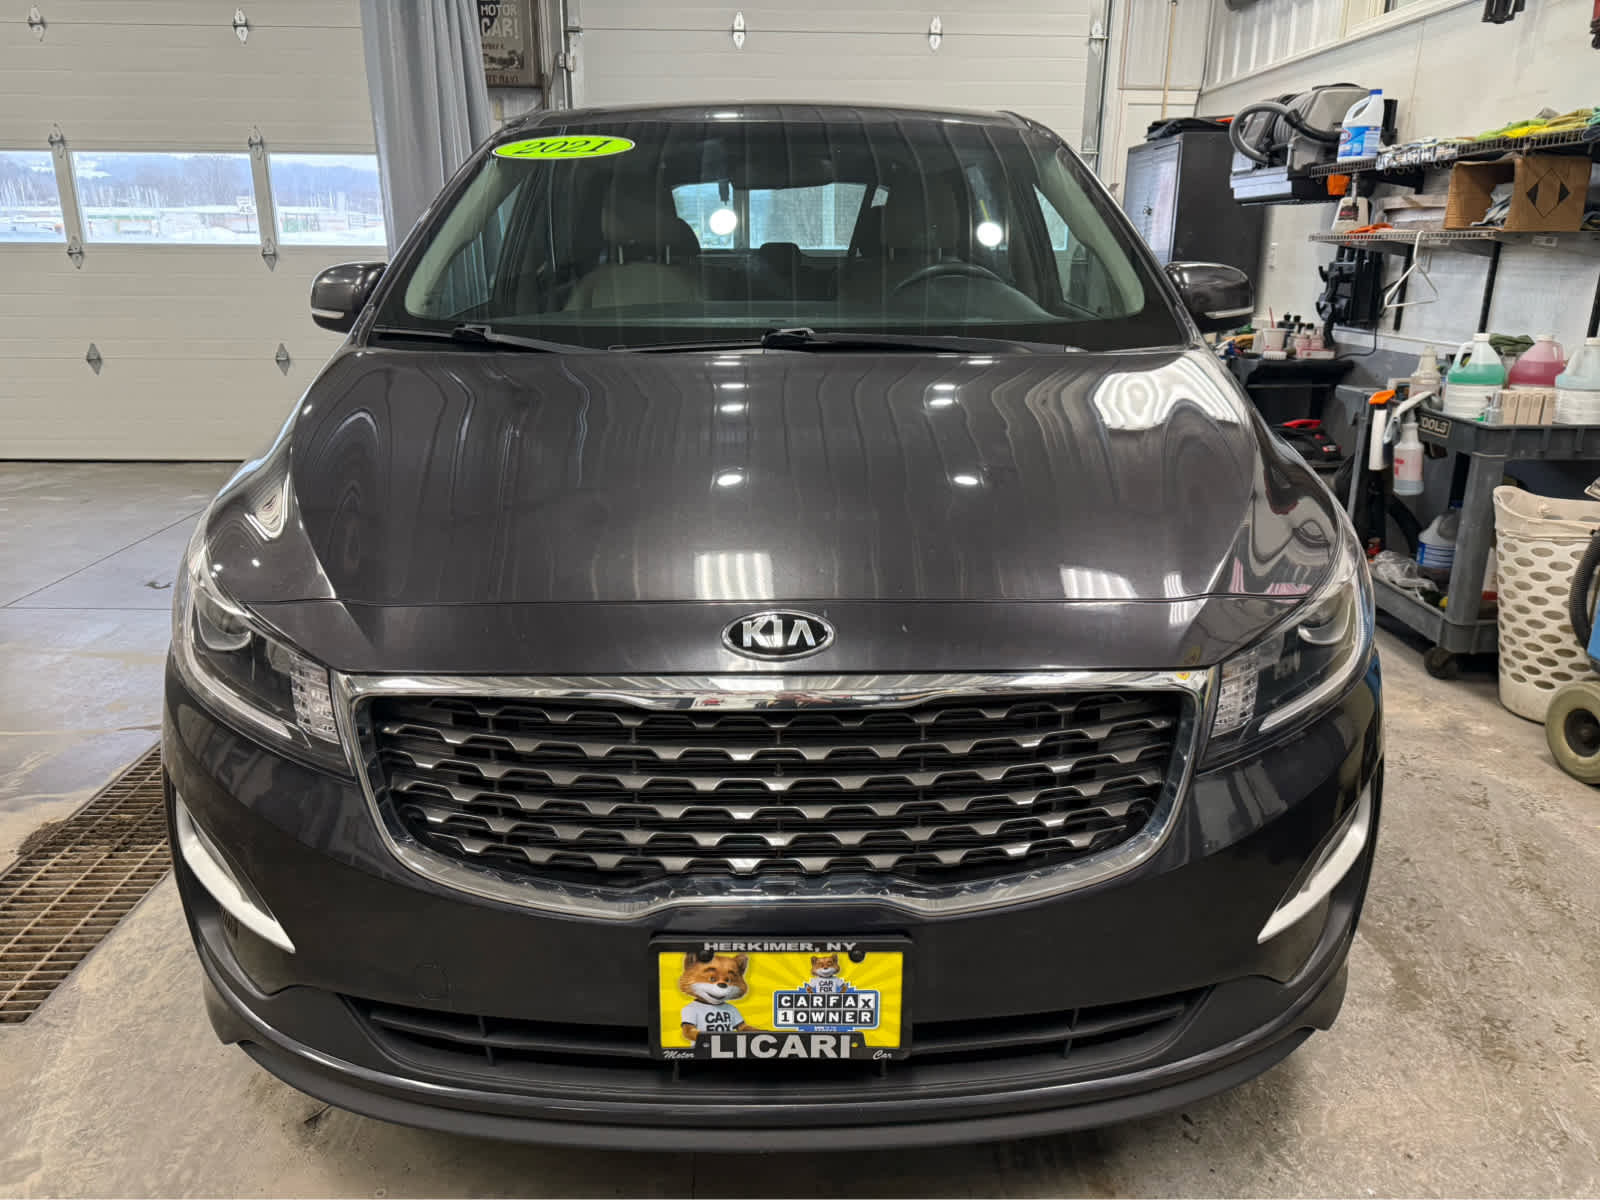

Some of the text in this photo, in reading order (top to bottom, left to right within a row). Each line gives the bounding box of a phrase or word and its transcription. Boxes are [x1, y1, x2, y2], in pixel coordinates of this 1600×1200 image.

[480, 4, 517, 16] MOTOR
[481, 17, 519, 39] CAR!
[512, 139, 613, 154] 2021
[741, 615, 816, 648] KIA
[703, 942, 857, 952] HERKIMER, NY
[780, 996, 873, 1008] CARFAX
[704, 1011, 731, 1024] CAR
[781, 1011, 872, 1022] 1 OWNER
[711, 1035, 851, 1059] LICARI
[663, 1050, 695, 1059] Motor
[872, 1049, 893, 1060] Car
